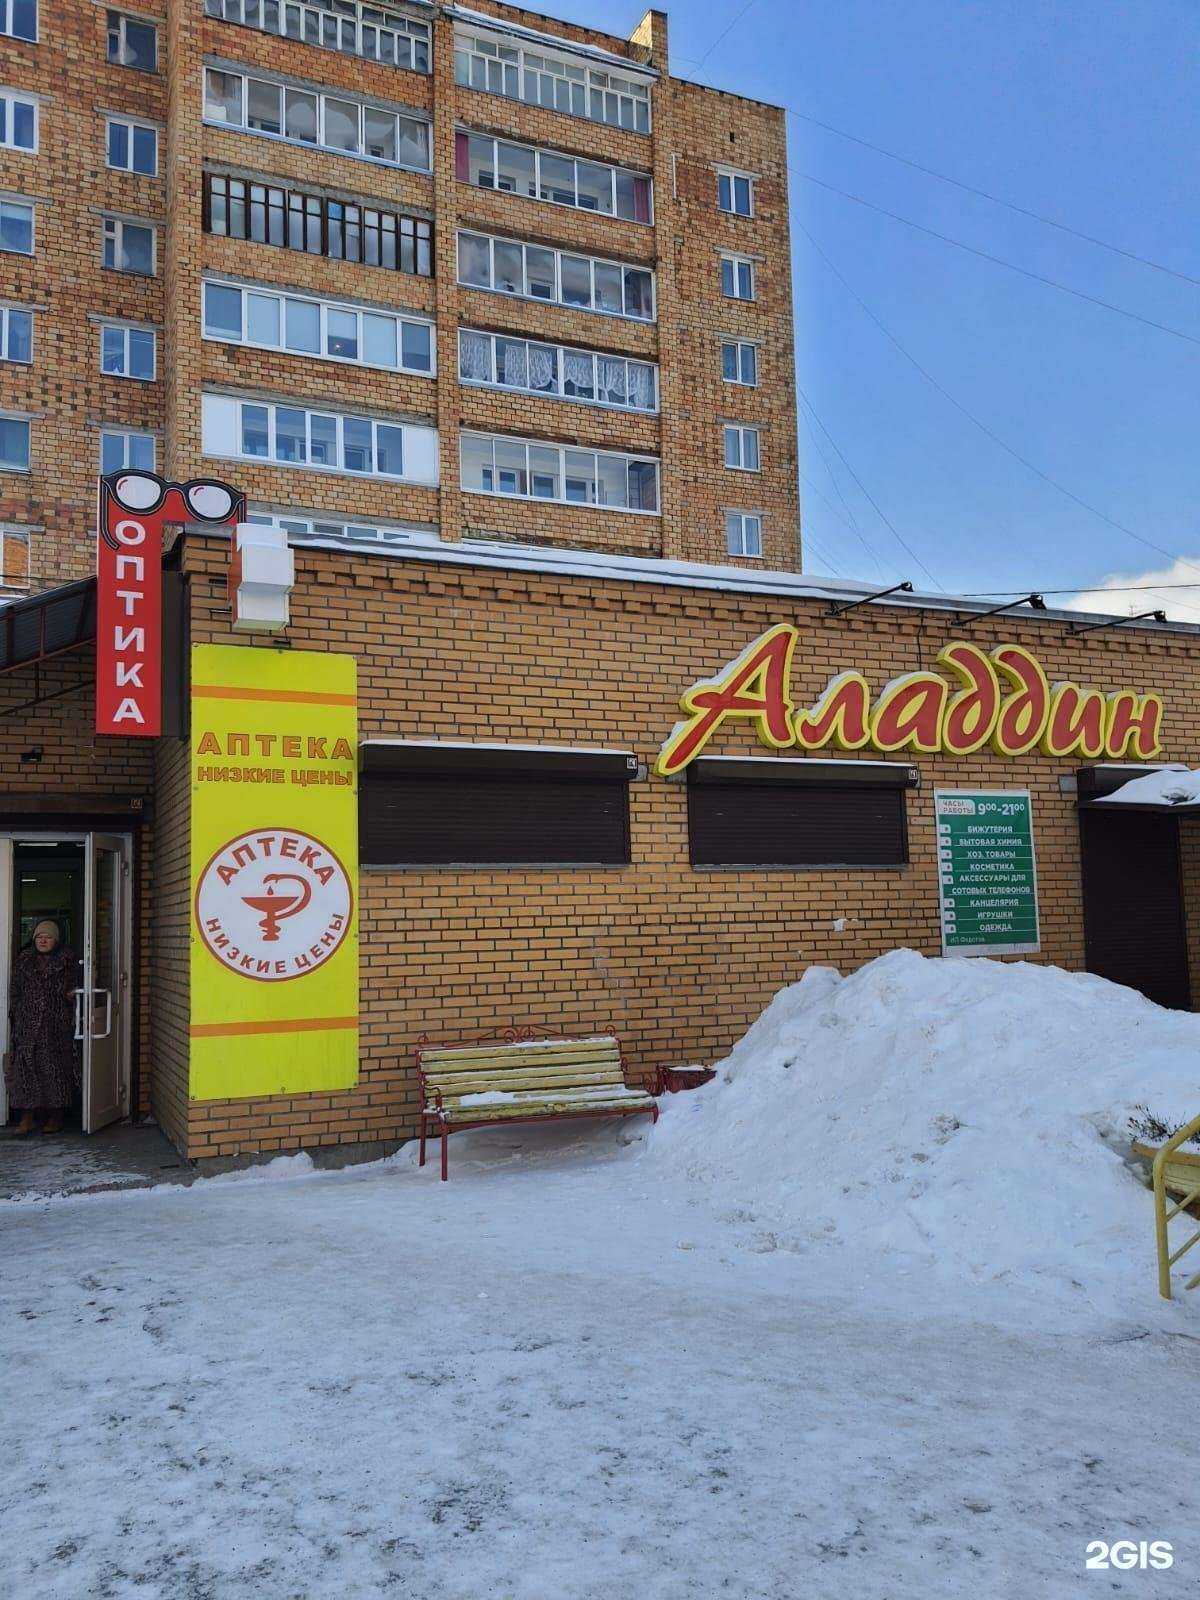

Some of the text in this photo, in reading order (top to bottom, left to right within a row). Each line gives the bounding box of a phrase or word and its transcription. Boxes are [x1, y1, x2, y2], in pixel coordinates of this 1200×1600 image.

[112, 519, 146, 724] ОПТИКА
[654, 622, 1163, 777] Аладдин
[197, 731, 354, 760] АПТЕКА
[197, 766, 353, 787] НИЗКИЕ ЦЕНЫ
[997, 838, 1022, 846] ХИМИЯ
[216, 837, 335, 886] АПТЕКА
[970, 863, 1015, 871] КОСМЕТИКА
[959, 874, 1026, 882] АКСЕССУАРЫ ДЛЯ
[952, 886, 1031, 895] СОТОВЫХ ТЕЛЕФОНОВ
[969, 899, 1019, 907] КАНЦЕЛЯРИЯ
[977, 911, 1013, 919] ИГРУШКИ
[979, 924, 1012, 932] ОДЕЖДА
[206, 913, 344, 974] НИЗКИЕ ЦЕНЫ
